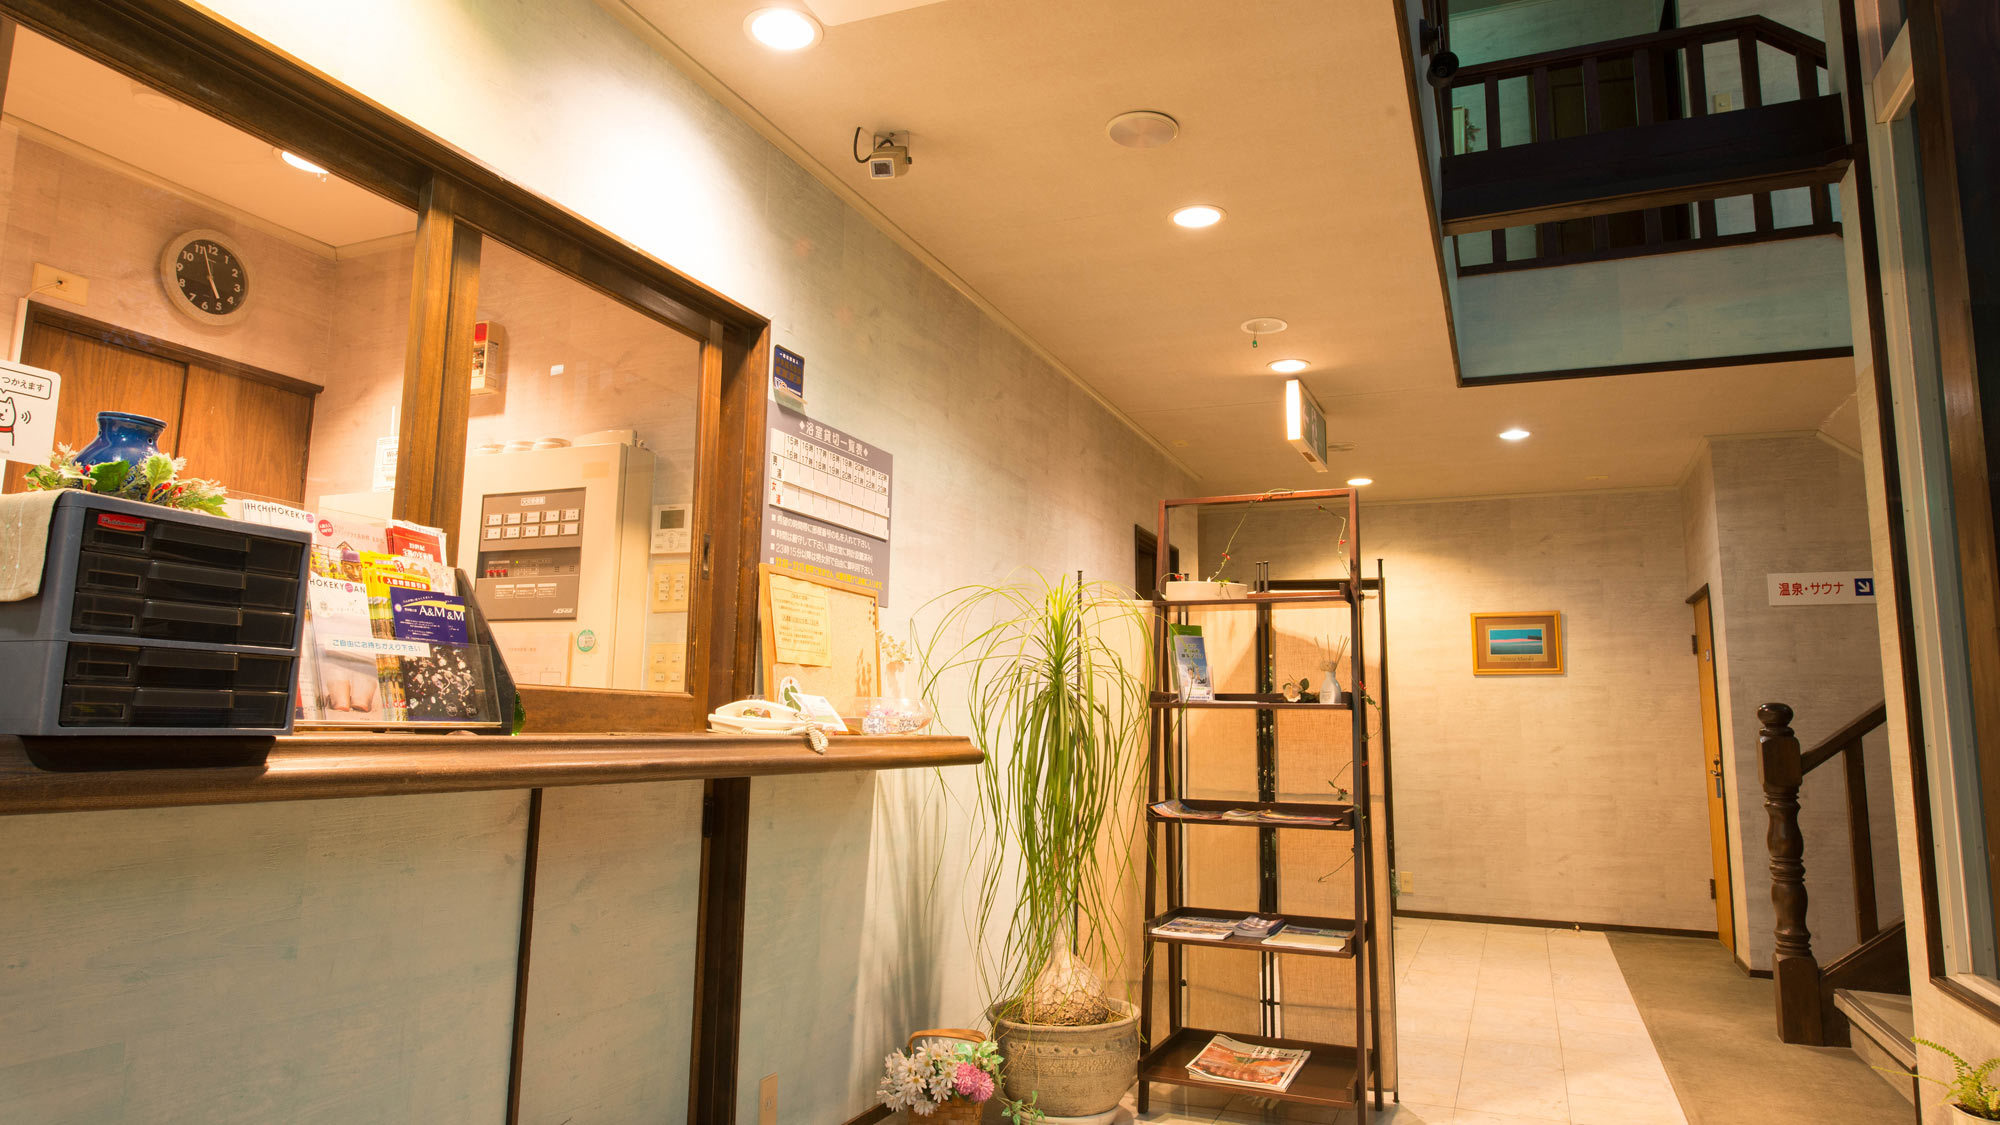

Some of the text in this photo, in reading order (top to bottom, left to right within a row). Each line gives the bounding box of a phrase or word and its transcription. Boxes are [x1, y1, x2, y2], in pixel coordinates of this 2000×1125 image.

[194, 244, 204, 254] 11
[208, 244, 219, 256] 12
[183, 251, 194, 262] 10
[224, 255, 229, 264] 1
[176, 263, 184, 271] 9
[232, 269, 238, 277] 2
[179, 278, 186, 287] 8
[234, 284, 241, 292] 3
[189, 293, 197, 301] 7
[227, 296, 234, 304] 4
[202, 302, 209, 310] 6
[216, 302, 222, 310] 5
[2, 376, 44, 392] つかえます
[806, 421, 864, 456] 浴室貸切一覧表
[1778, 582, 1844, 596] 温泉・サウナ
[419, 606, 445, 617] A&M
[447, 611, 464, 621] &M
